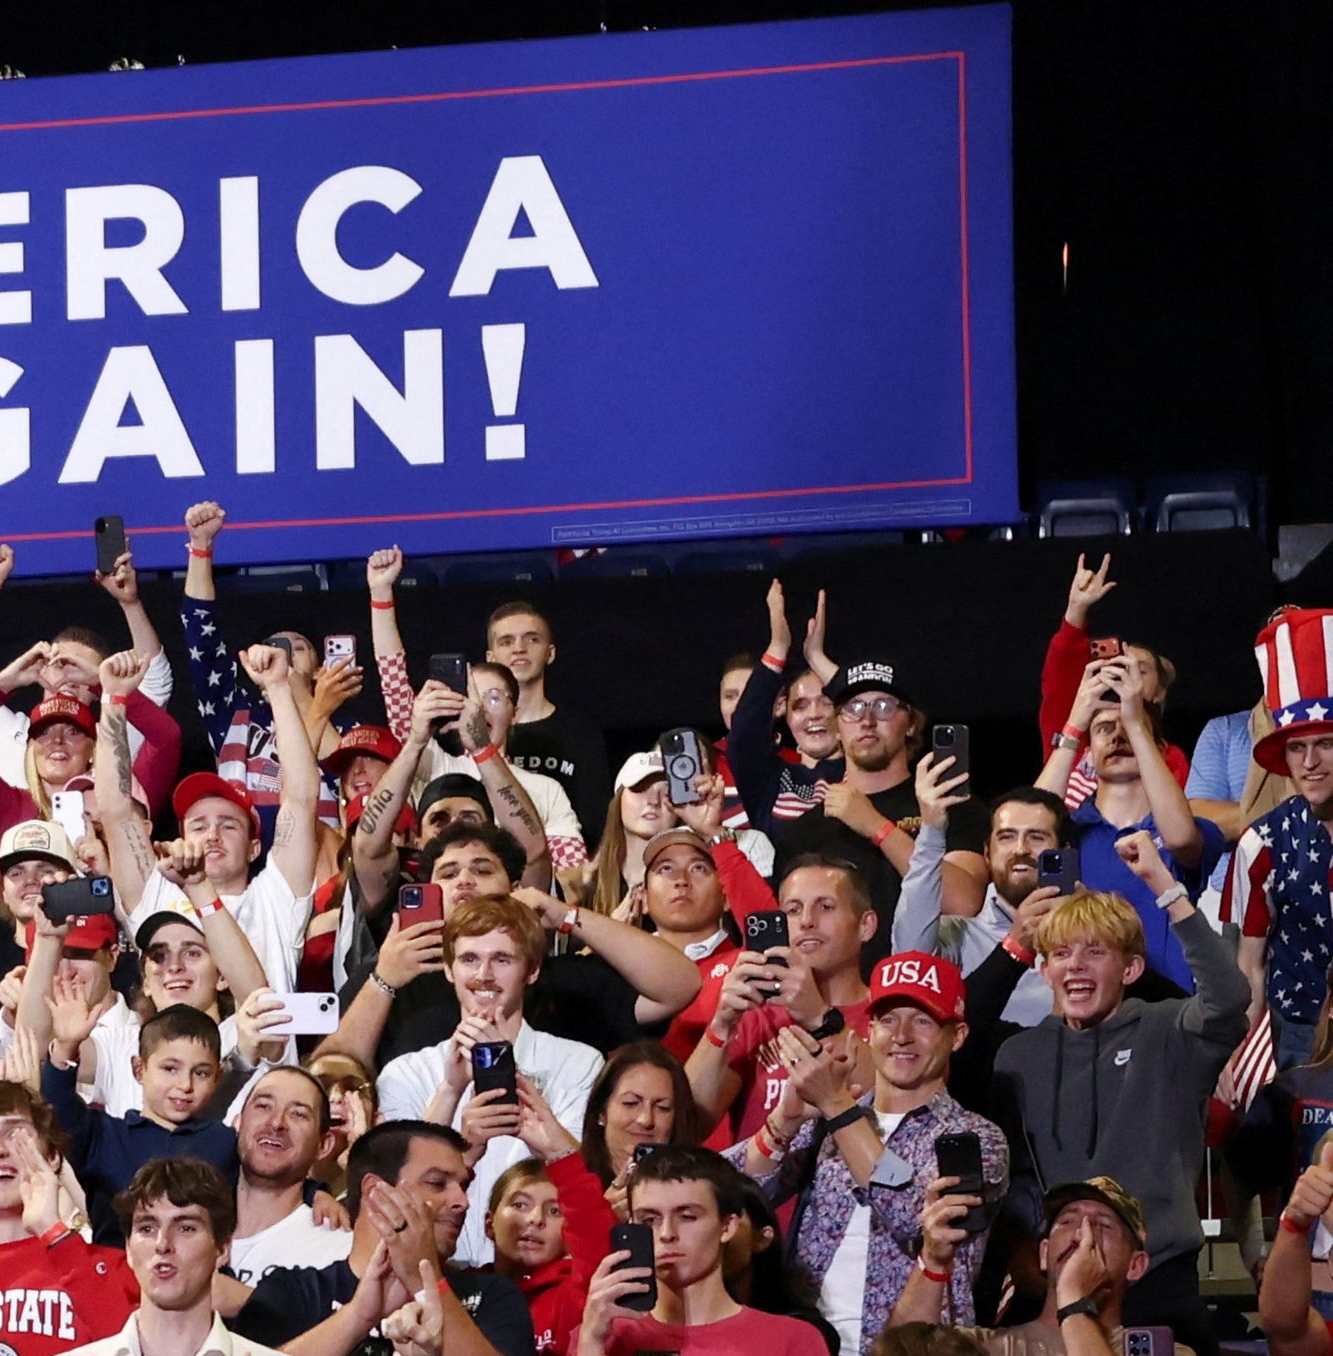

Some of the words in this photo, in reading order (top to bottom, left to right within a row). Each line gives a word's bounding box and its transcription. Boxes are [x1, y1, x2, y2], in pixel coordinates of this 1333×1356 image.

[848, 661, 874, 677] LET'S
[875, 662, 894, 674] GO
[514, 755, 575, 777] EDOM
[881, 960, 942, 994] USA
